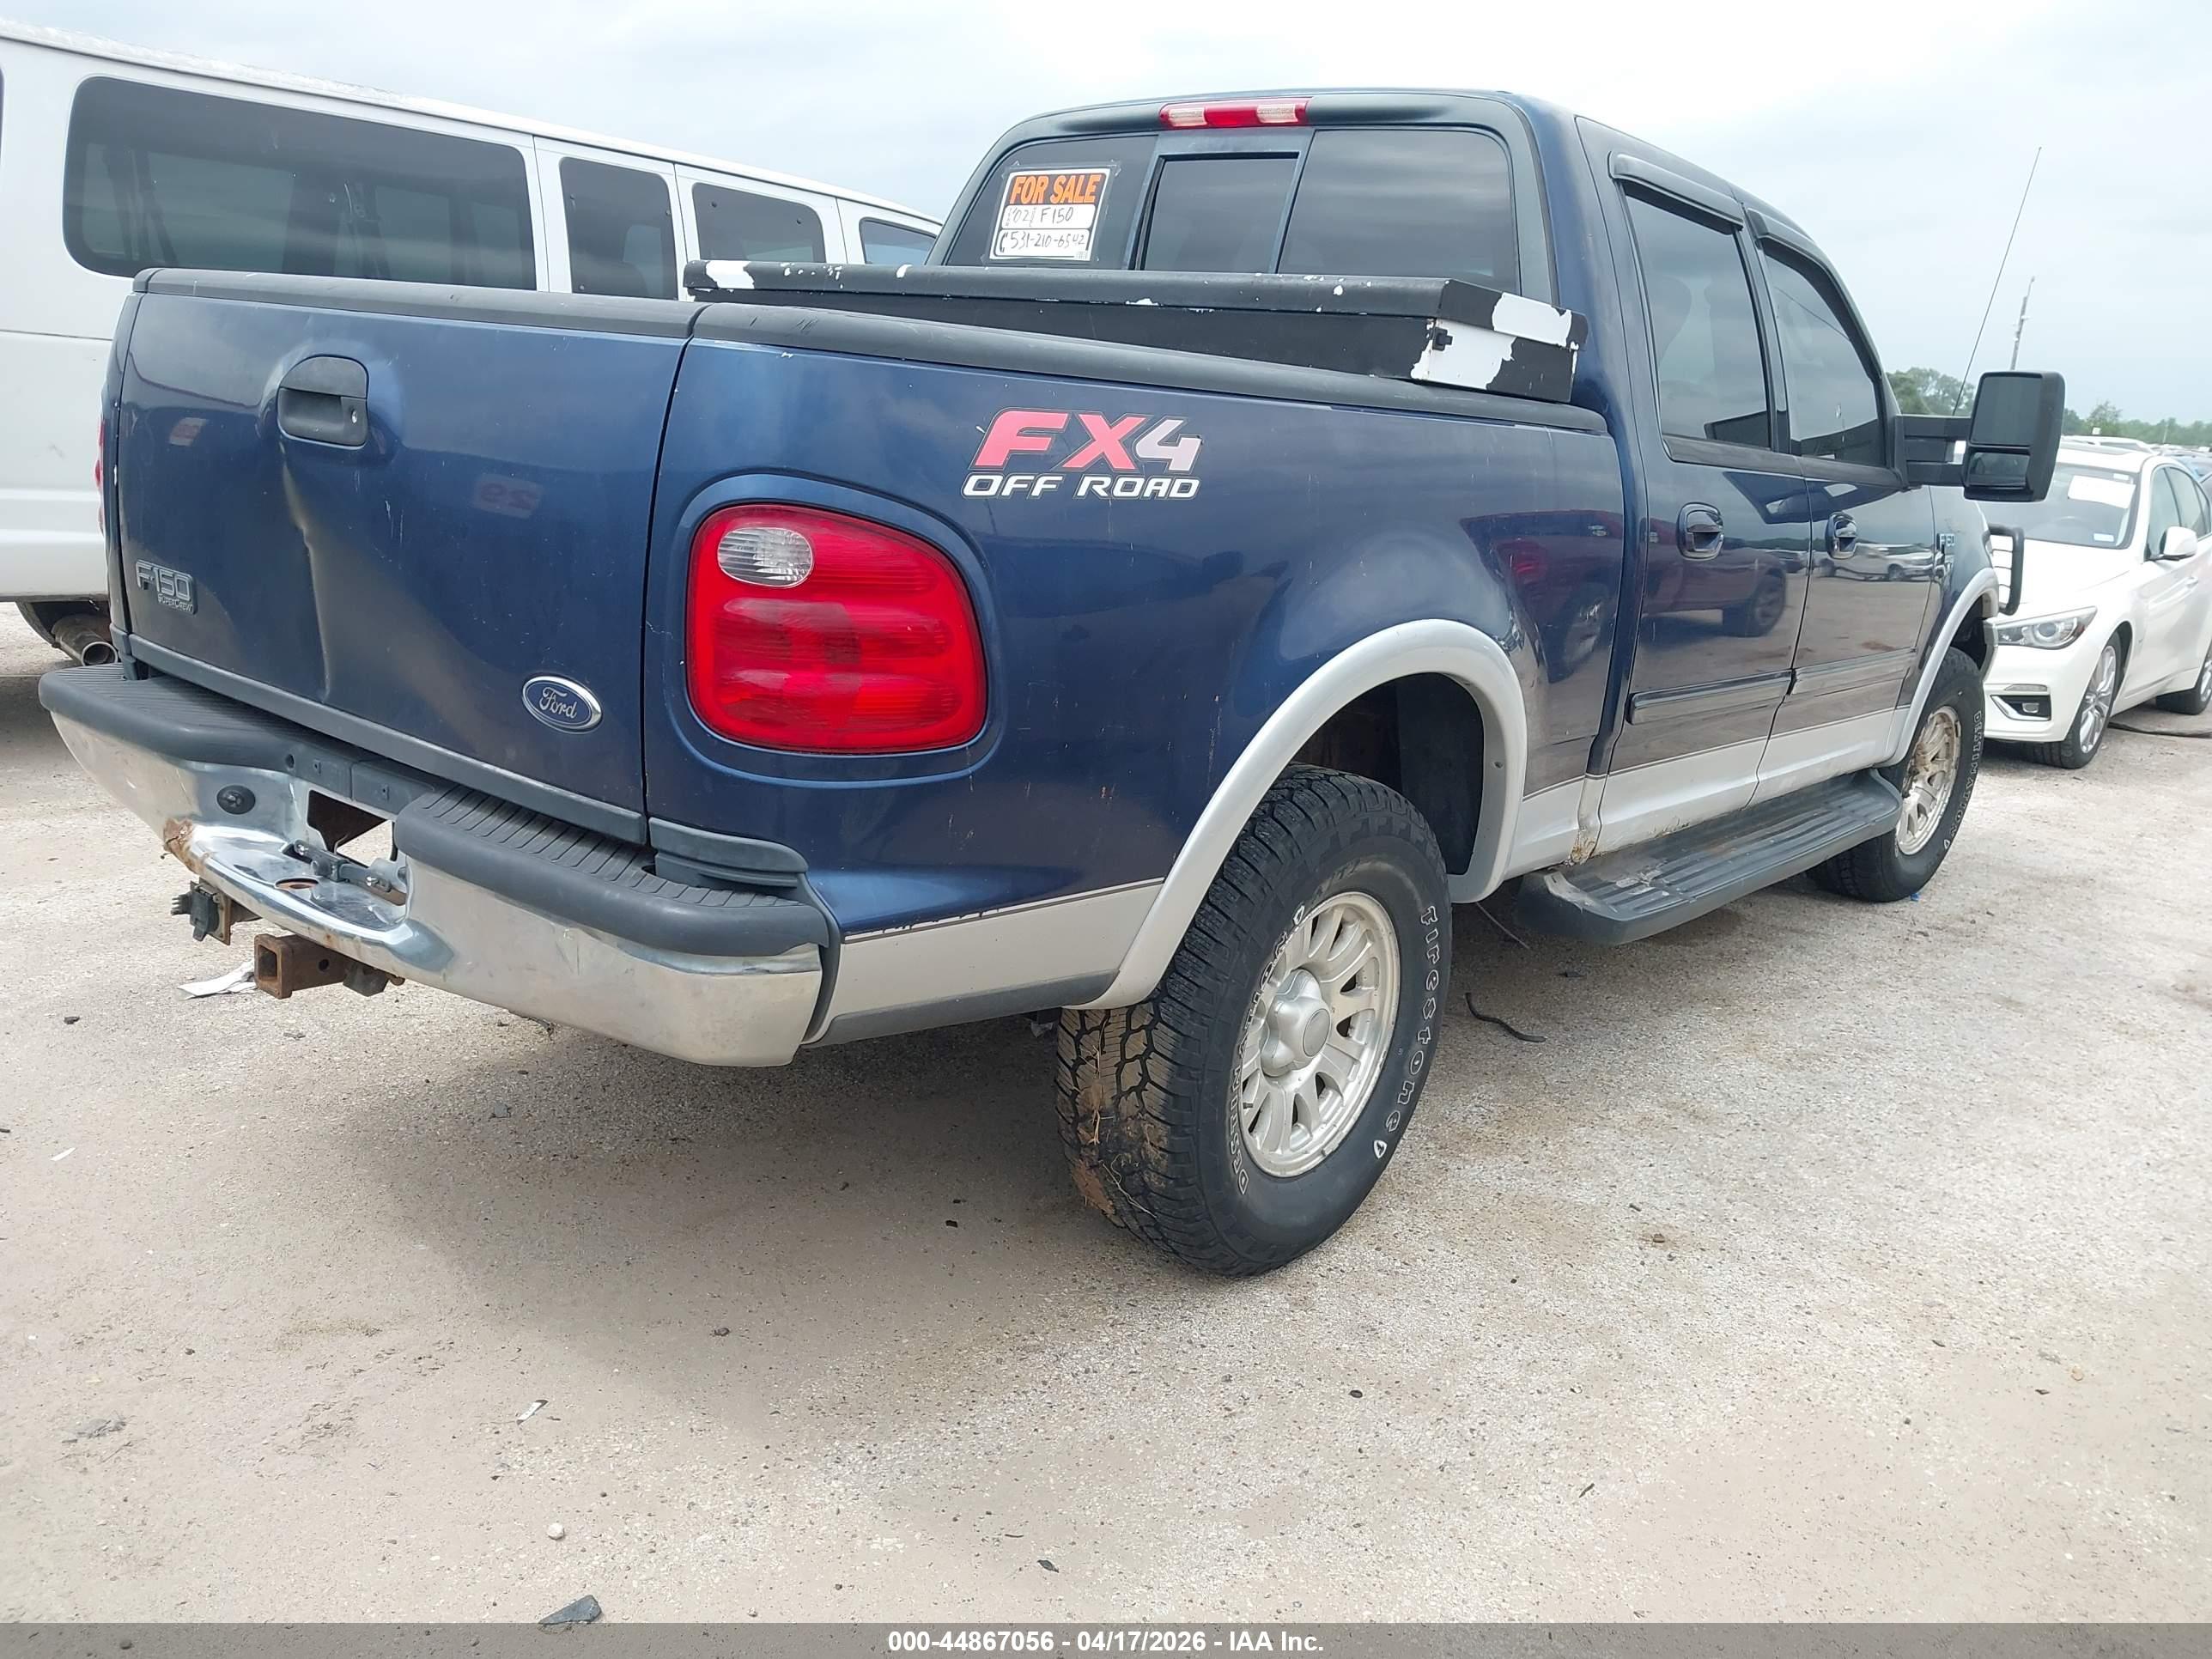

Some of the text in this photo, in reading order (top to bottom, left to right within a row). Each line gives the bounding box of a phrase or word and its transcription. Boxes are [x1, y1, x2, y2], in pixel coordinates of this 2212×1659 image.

[1009, 173, 1102, 204] FOR SALE
[971, 409, 1202, 472] FX4
[963, 475, 1200, 499] OFF ROAD
[539, 687, 577, 719] Ford
